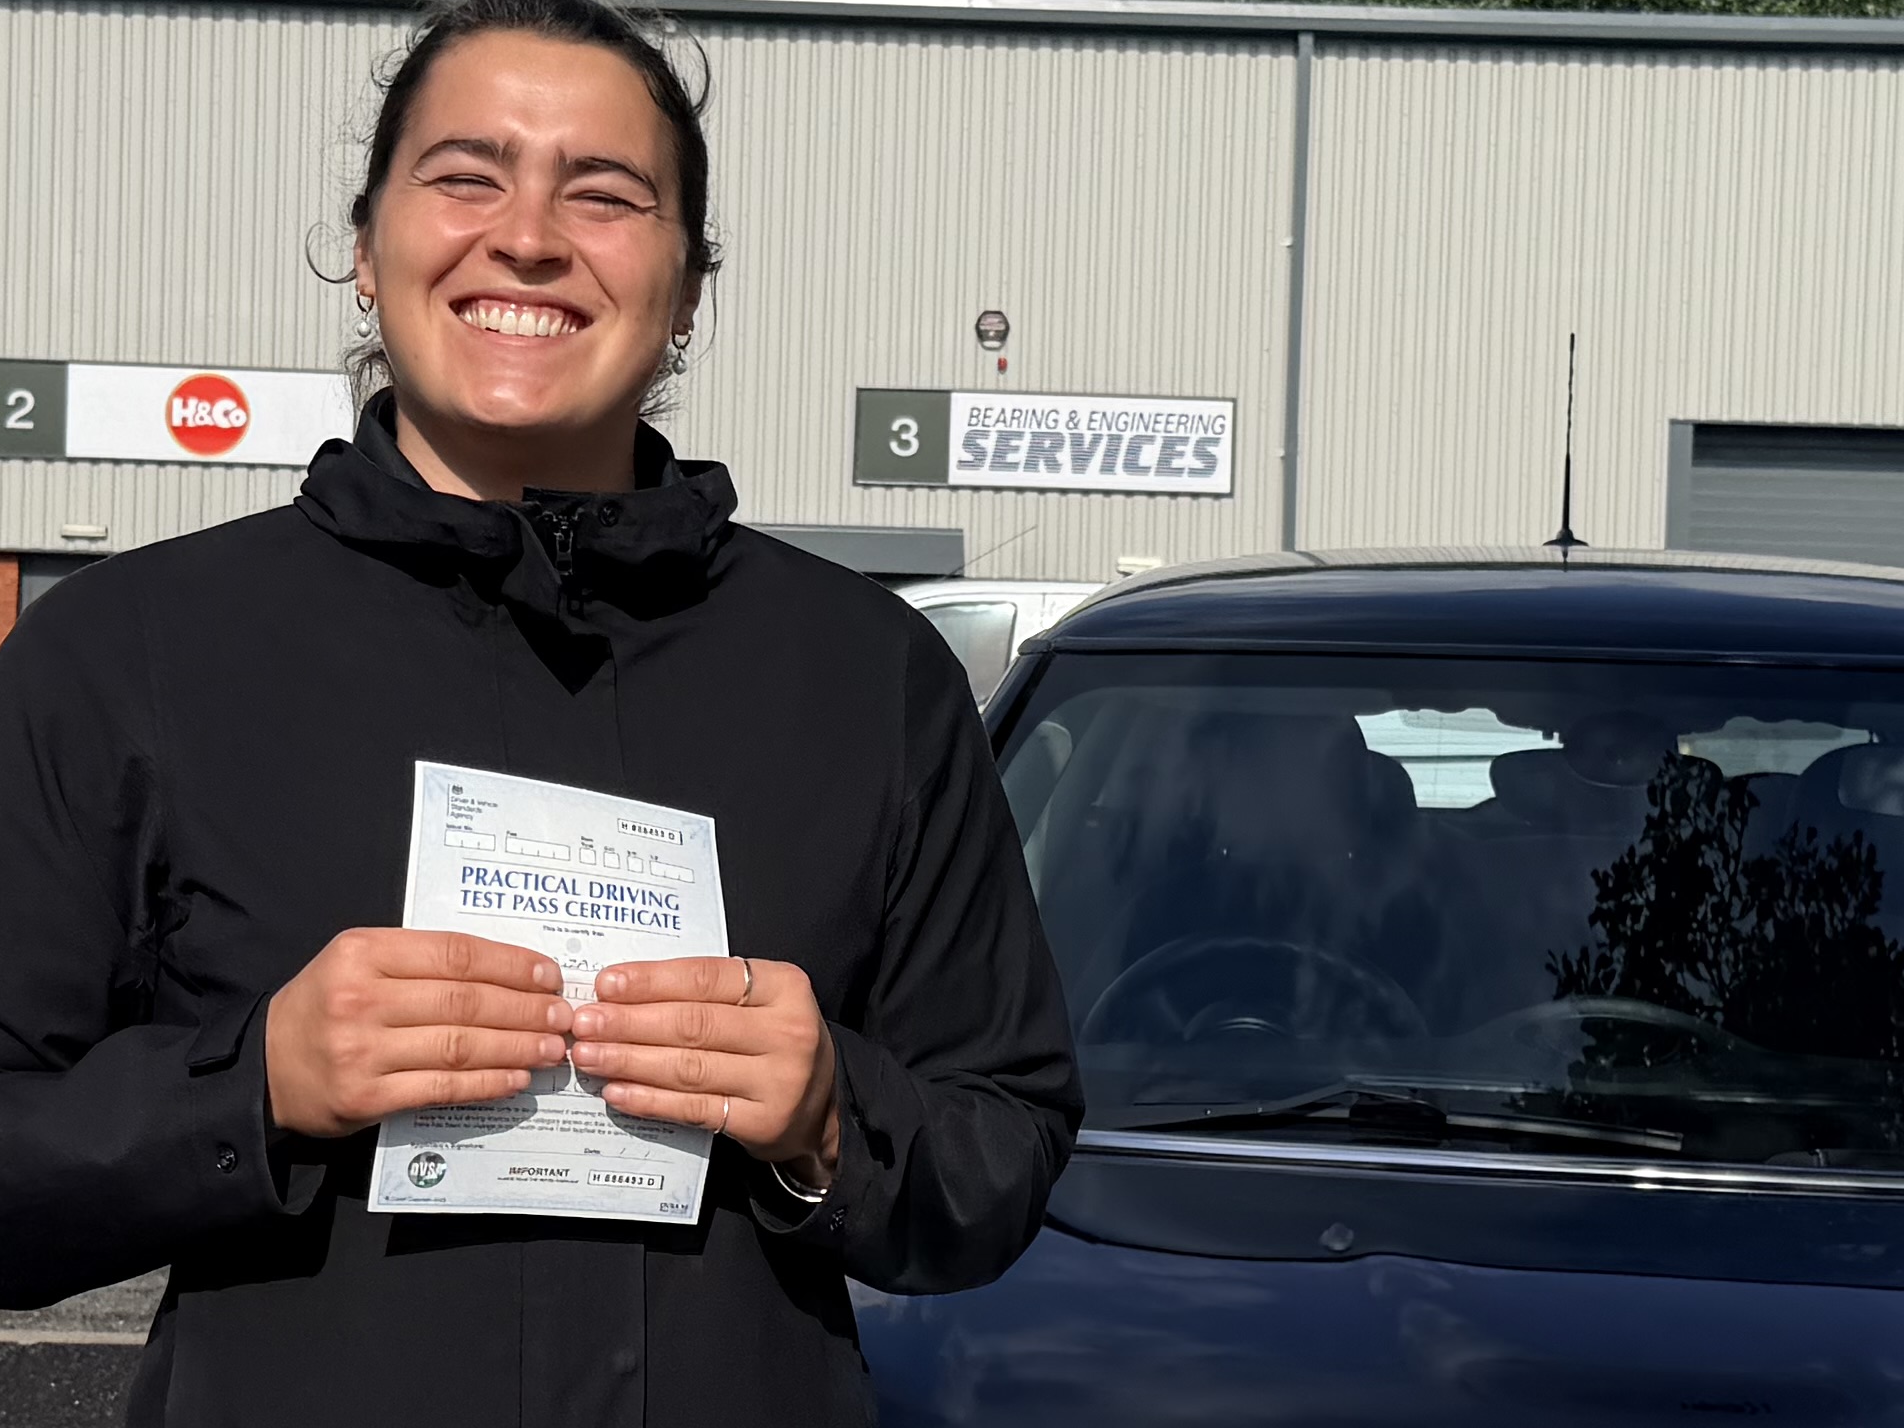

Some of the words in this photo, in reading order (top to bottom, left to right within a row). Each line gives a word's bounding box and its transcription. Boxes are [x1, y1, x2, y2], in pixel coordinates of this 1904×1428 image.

[4, 388, 36, 430] 2
[170, 397, 248, 431] H&Co
[967, 407, 1060, 430] BEARING
[1065, 410, 1081, 430] &
[1086, 411, 1227, 435] ENGINEERING
[888, 418, 920, 457] 3
[956, 429, 1222, 478] SERVICES
[461, 866, 582, 897] PRACTICAL
[589, 880, 680, 911] DRIVING
[460, 889, 506, 909] TEST
[513, 894, 559, 914] PASS
[565, 900, 681, 931] CERTIFICATE
